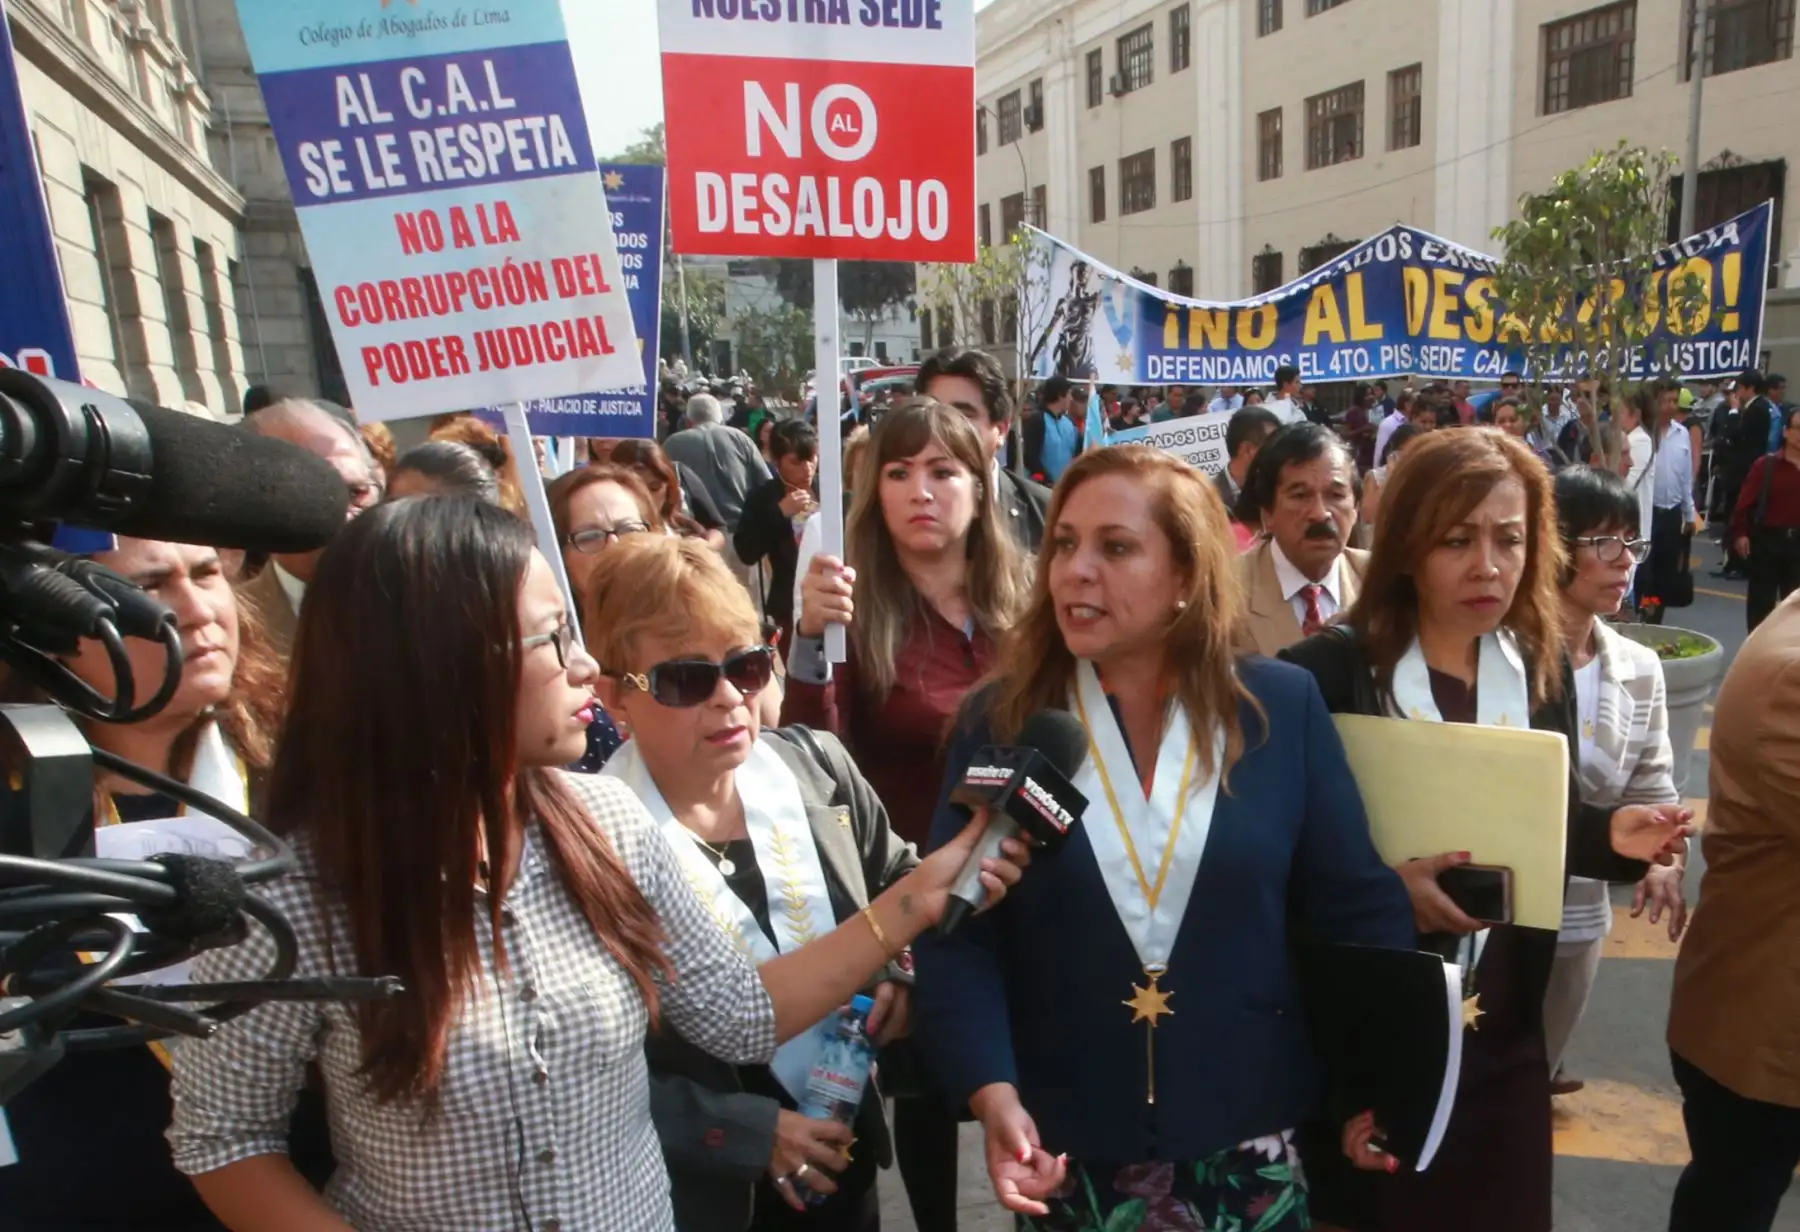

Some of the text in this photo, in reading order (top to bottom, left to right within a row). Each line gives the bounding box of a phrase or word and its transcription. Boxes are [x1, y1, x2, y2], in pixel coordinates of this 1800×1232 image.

[299, 8, 510, 46] Colegio de Abogados de Lima
[859, 0, 942, 29] SEDE
[336, 60, 516, 127] AL C.A.L
[743, 80, 878, 161] NO
[831, 113, 859, 132] AL
[299, 114, 577, 197] SE LE RESPETA
[394, 201, 521, 255] NO A LA
[695, 172, 949, 241] DESALOJO
[334, 253, 611, 328] CORRUPCIÓN DEL
[1302, 272, 1384, 346] AL
[360, 315, 615, 387] PODER JUDICIAL
[1148, 354, 1292, 380] DEFENDAMOS
[1299, 352, 1324, 376] EL
[1329, 347, 1375, 374] 4TO.
[1420, 345, 1466, 372] SEDE
[1472, 349, 1509, 375] CAL
[539, 399, 582, 415] PALACIO
[583, 400, 598, 415] DE
[598, 400, 643, 416] JUSTICIA
[1197, 424, 1220, 442] DE
